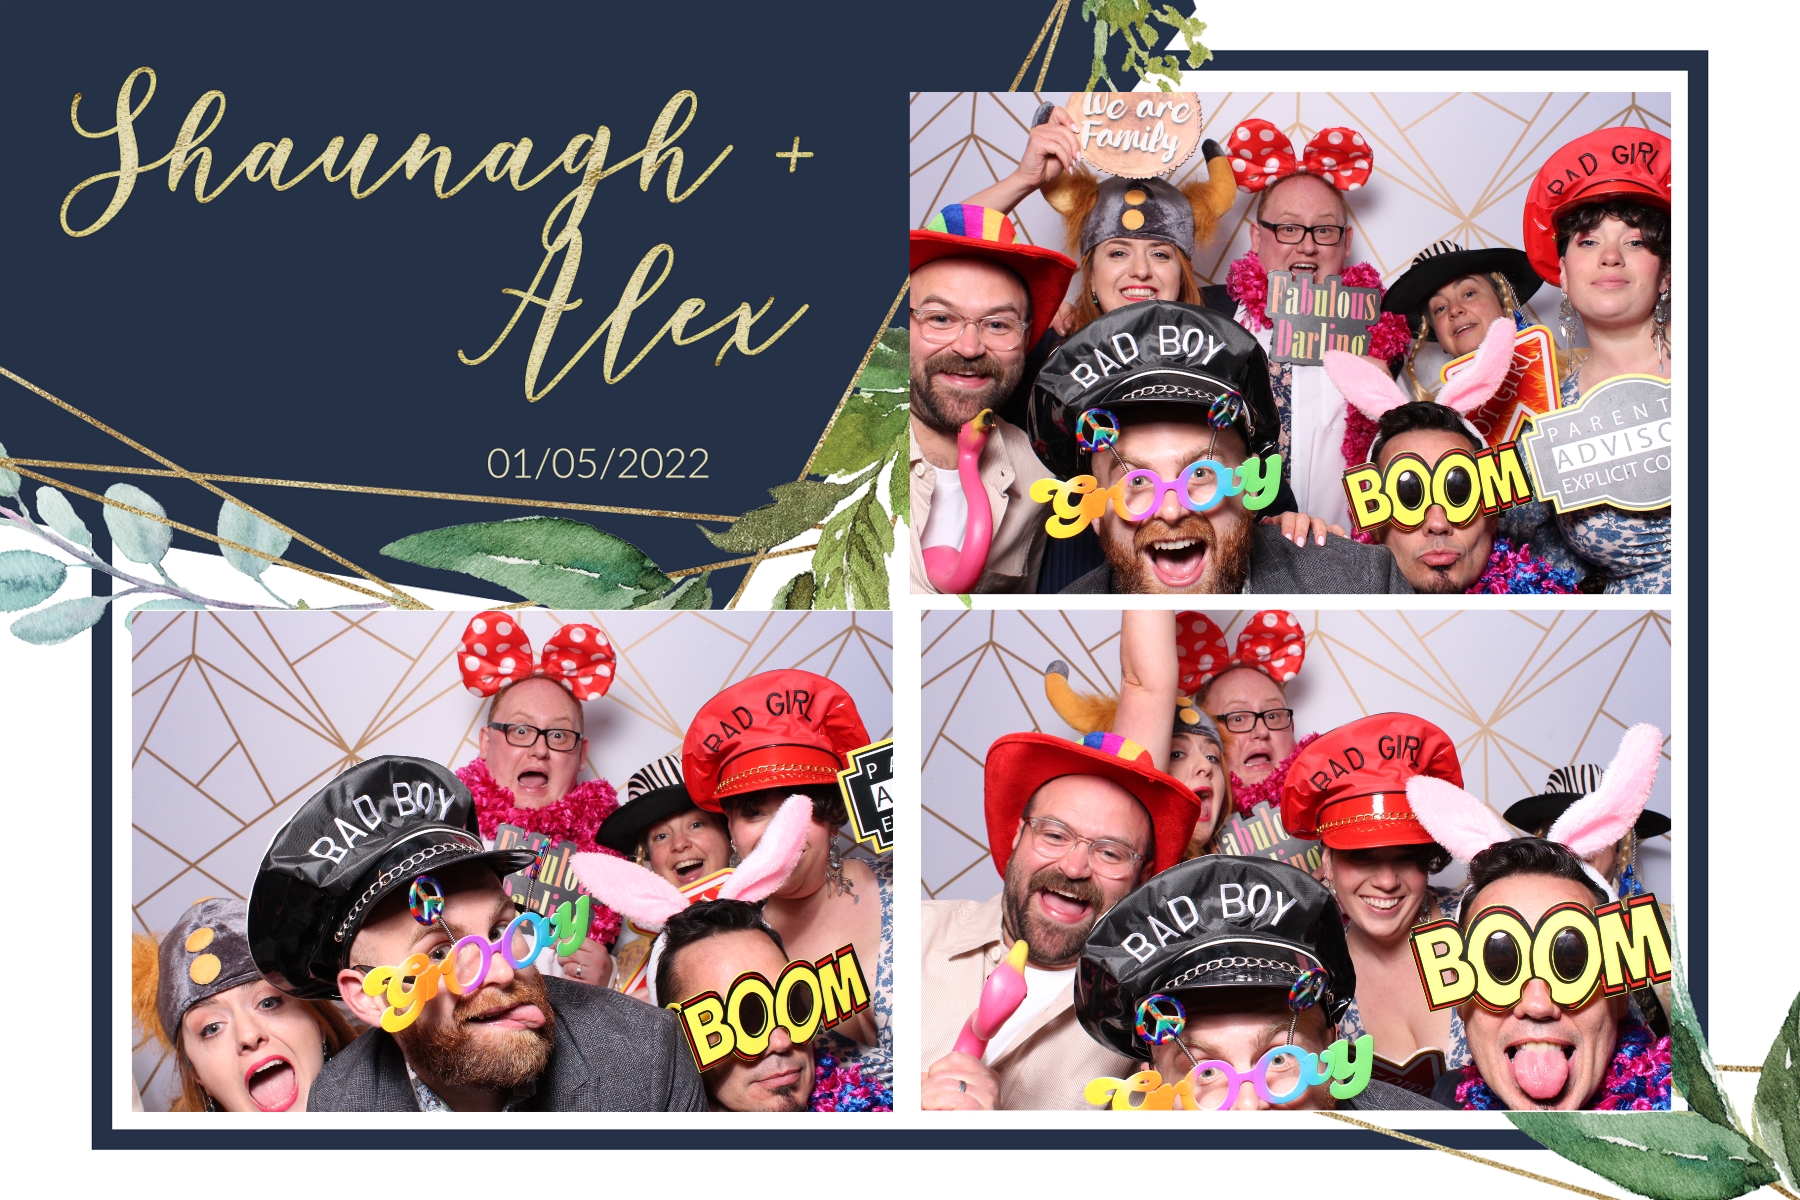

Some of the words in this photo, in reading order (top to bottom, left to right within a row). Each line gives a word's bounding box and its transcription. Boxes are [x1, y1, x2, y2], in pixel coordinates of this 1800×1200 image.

[1082, 92, 1129, 120] We
[1136, 98, 1194, 124] are
[1081, 120, 1182, 163] Family
[1612, 141, 1660, 175] GIRL
[1270, 275, 1377, 321] Fabulous
[1070, 332, 1139, 389] BAD
[1158, 325, 1227, 366] BOY
[1341, 441, 1535, 533] BOOM
[1561, 461, 1638, 494] EXPLICIT
[1643, 453, 1671, 474] CO
[702, 705, 754, 752] BAD
[766, 689, 816, 722] GIRL
[1309, 746, 1365, 791] BAD
[309, 794, 382, 865] BAD
[392, 782, 456, 821] BOY
[1120, 895, 1199, 964] BAD
[1220, 883, 1298, 927] BOY
[1408, 892, 1671, 1012] BOOM
[677, 942, 871, 1074] BOOM
